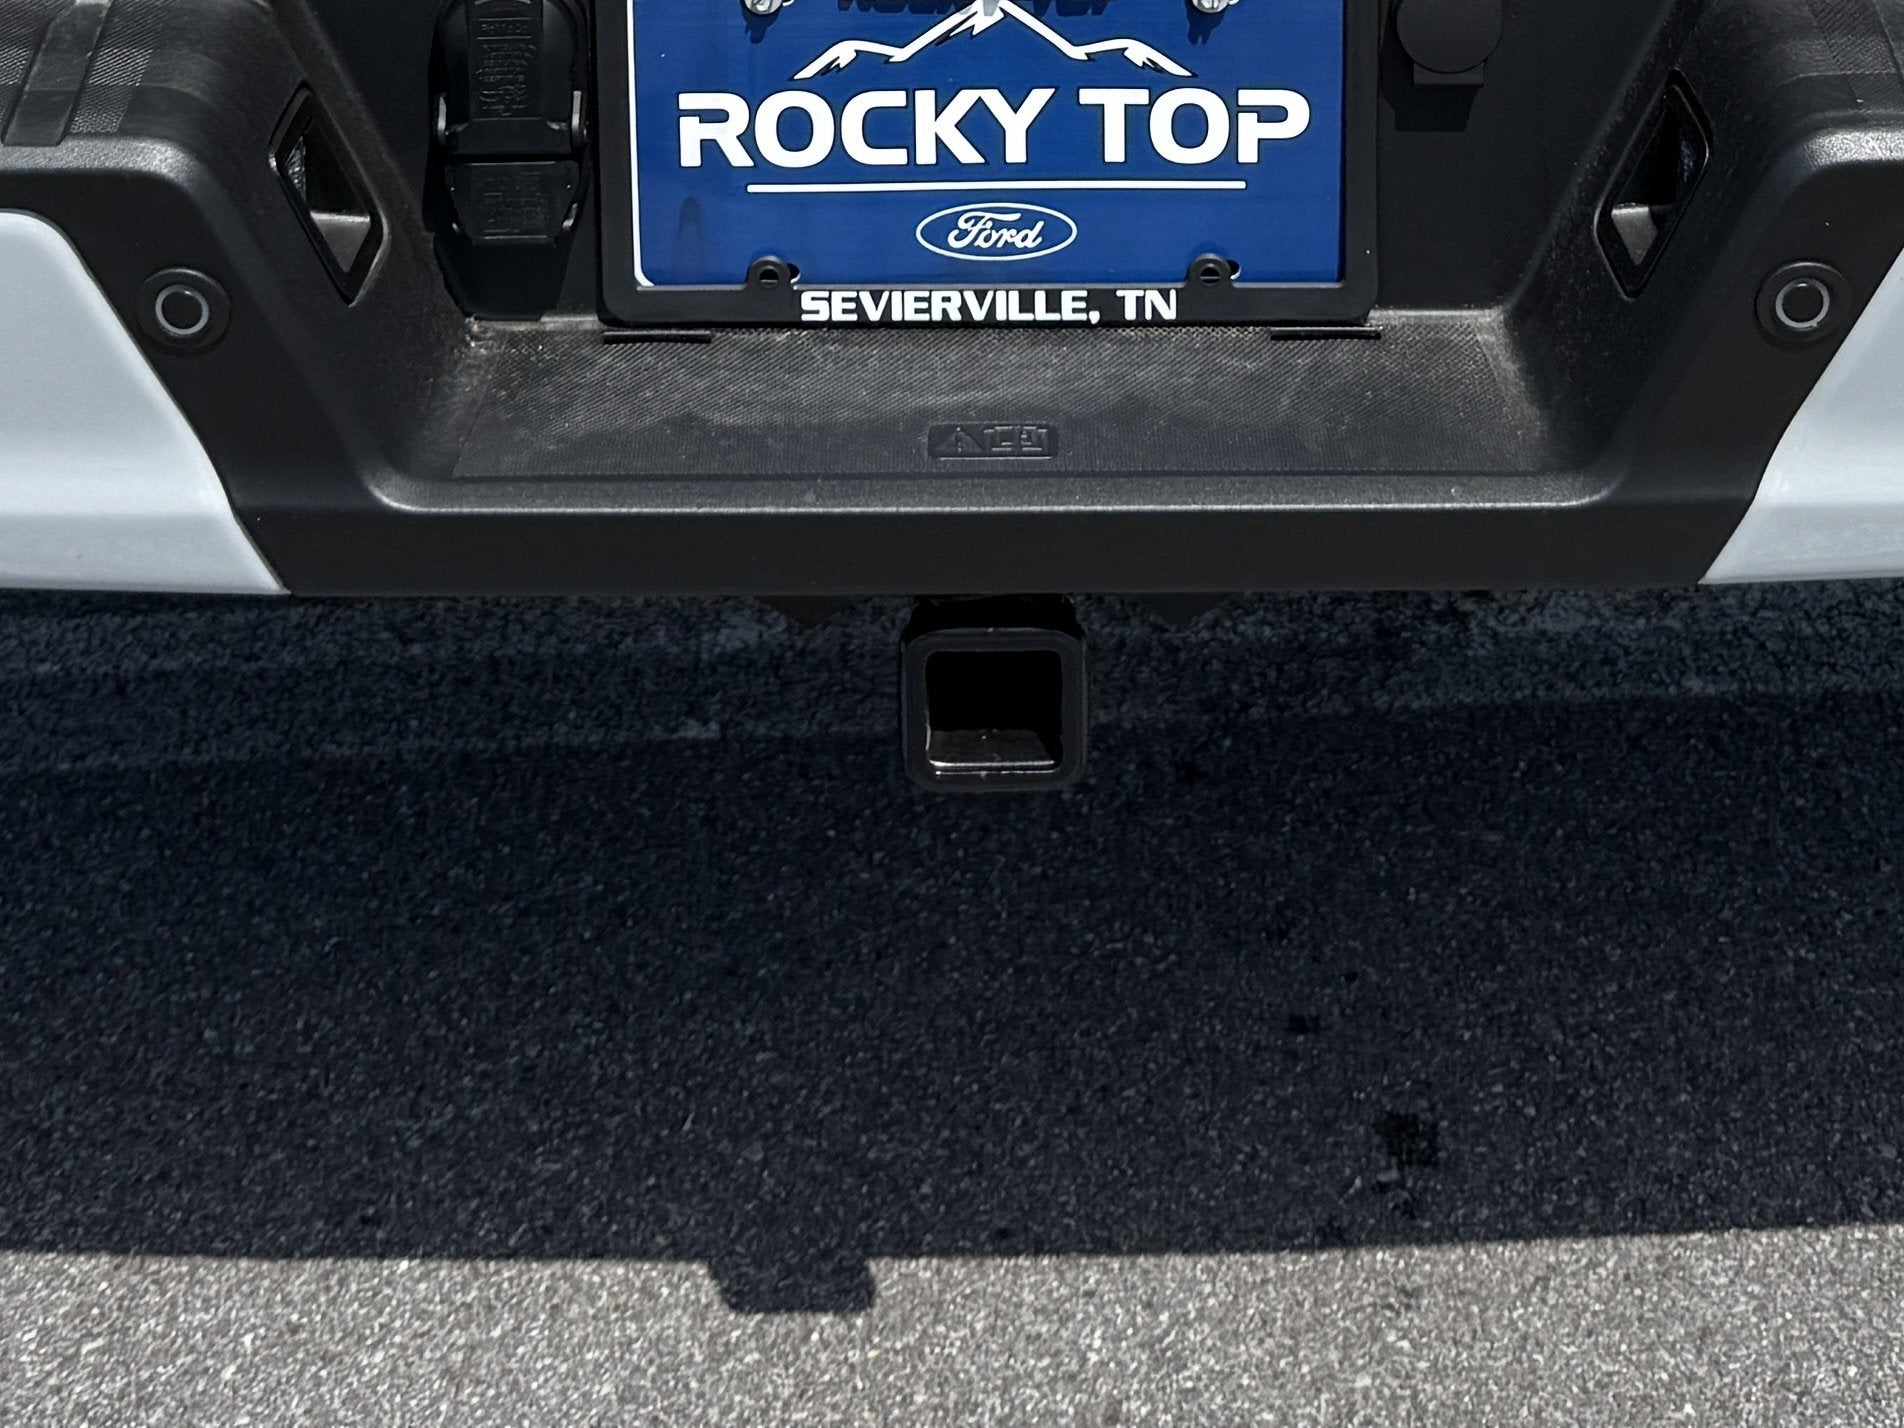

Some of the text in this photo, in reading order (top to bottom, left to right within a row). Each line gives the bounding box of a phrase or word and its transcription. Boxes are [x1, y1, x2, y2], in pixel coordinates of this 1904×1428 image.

[677, 86, 1311, 168] ROCKY TOP
[946, 209, 1047, 252] Ford
[799, 287, 1179, 325] SEVIERVILLE, TN
